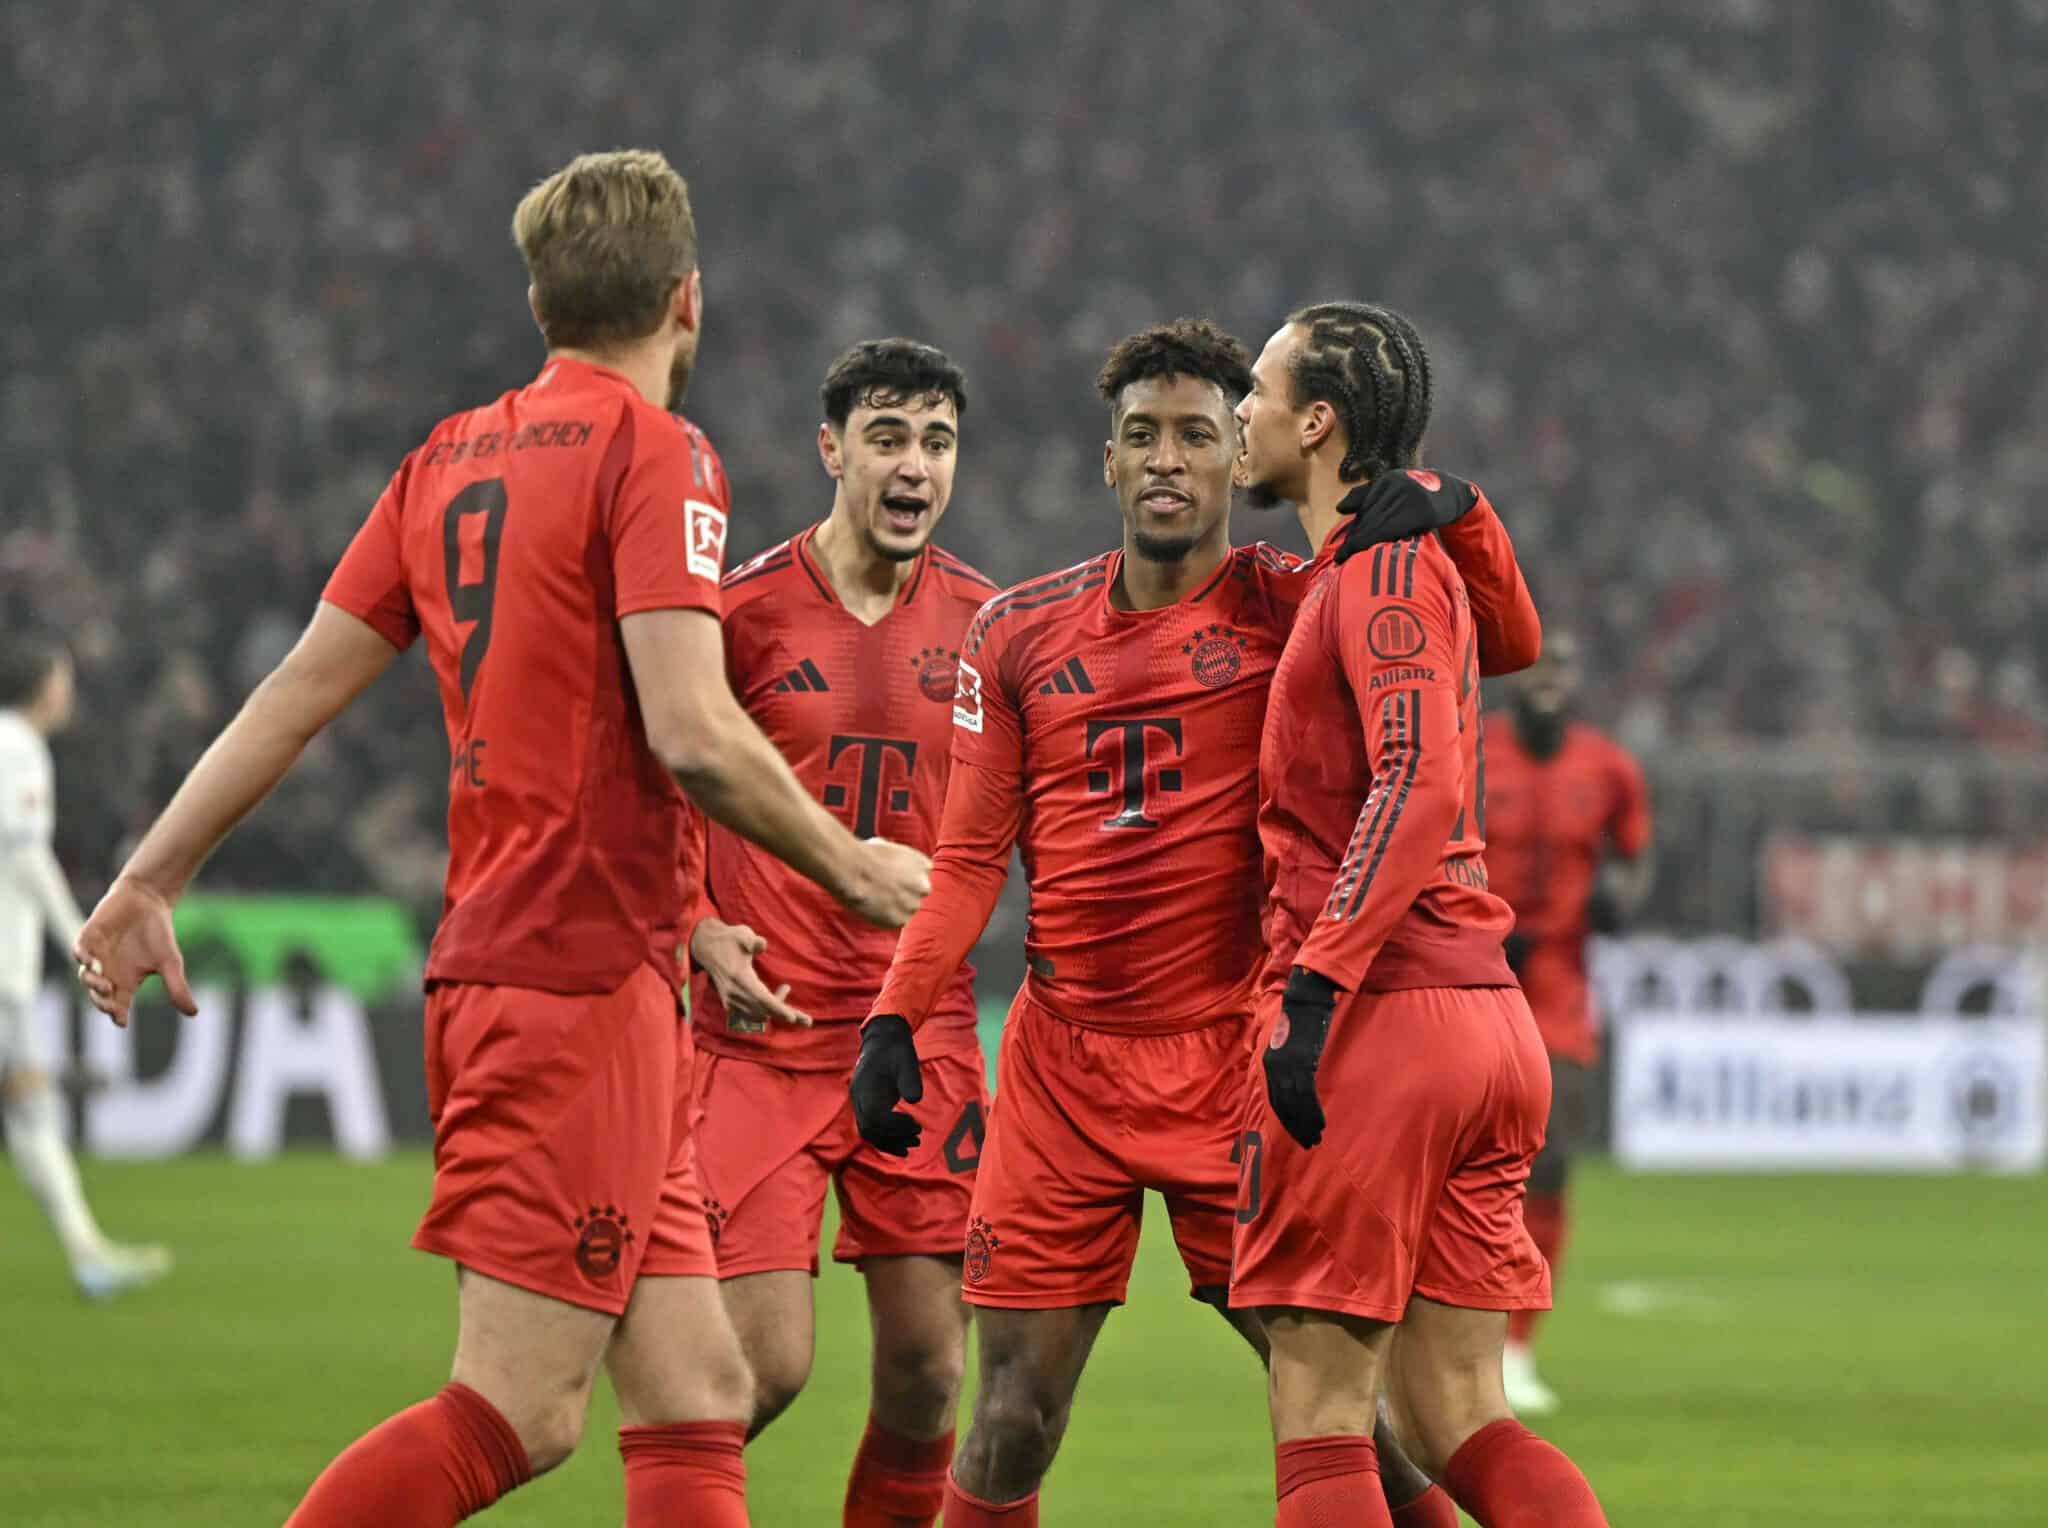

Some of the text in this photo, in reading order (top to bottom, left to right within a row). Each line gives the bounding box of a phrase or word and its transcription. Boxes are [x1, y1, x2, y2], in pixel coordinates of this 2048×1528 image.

[443, 477, 509, 707] 9
[1368, 667, 1436, 692] Allianz
[1085, 717, 1184, 829] T
[943, 1099, 990, 1175] 4
